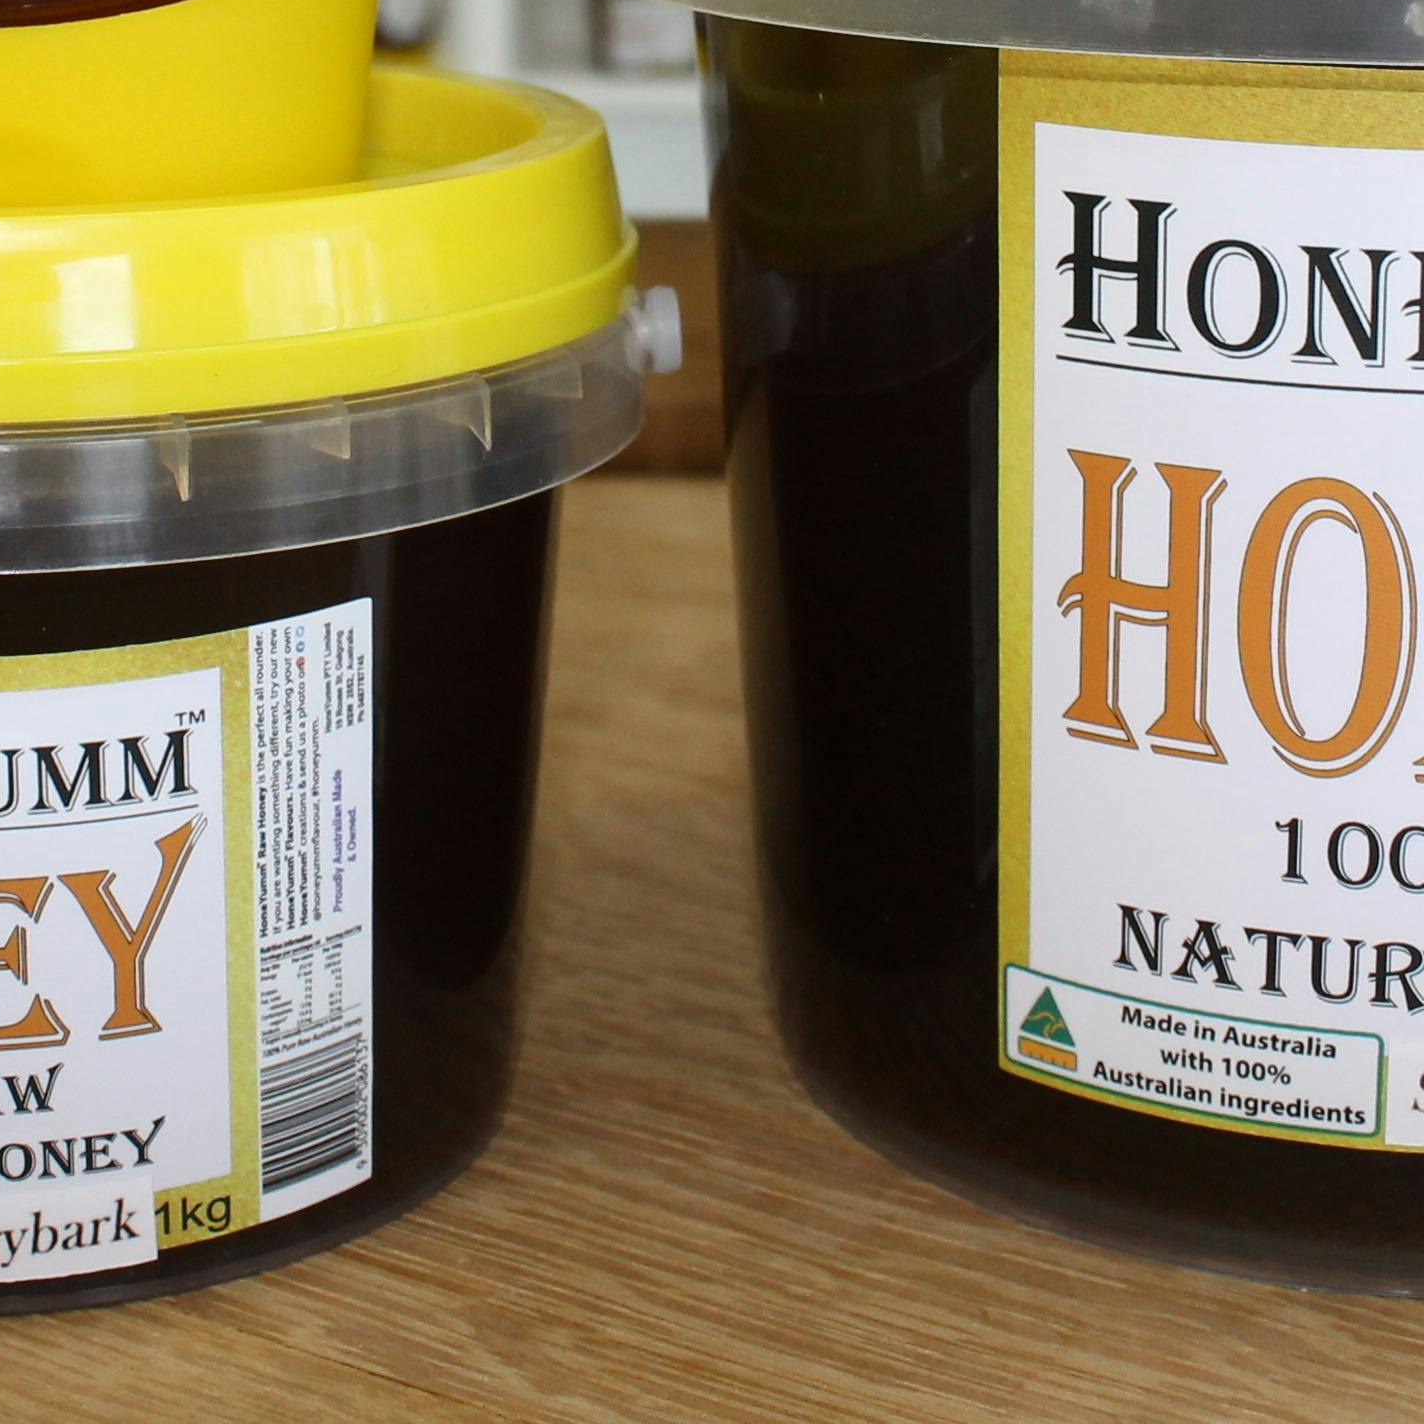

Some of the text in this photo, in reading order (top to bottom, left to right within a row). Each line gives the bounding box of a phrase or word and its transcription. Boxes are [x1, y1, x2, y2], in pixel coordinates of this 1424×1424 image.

[269, 628, 277, 654] new
[283, 626, 291, 654] own
[270, 657, 278, 679] our
[284, 657, 293, 685] your
[254, 687, 264, 701] all
[269, 681, 280, 699] try
[297, 681, 307, 719] photo
[283, 687, 294, 733] making
[255, 703, 266, 748] perfect
[299, 731, 306, 746] us
[283, 735, 293, 757] fun
[256, 751, 265, 772] the
[284, 759, 293, 790] Have
[297, 747, 306, 777] send
[256, 773, 265, 784] is
[270, 758, 281, 824] something
[297, 779, 306, 789] &
[257, 786, 267, 829] Honey
[299, 791, 307, 846] creations
[257, 830, 267, 859] Raw
[271, 826, 283, 878] wanting
[331, 768, 344, 912] Proudly Australian Made
[346, 852, 357, 862] &
[273, 879, 282, 898] are
[274, 900, 284, 924] you
[271, 925, 282, 935] If
[1120, 1005, 1337, 1059] Made in Australia
[1160, 1047, 1291, 1086] with 100%
[1092, 1060, 1366, 1125] Australian ingredients
[153, 1192, 232, 1237] 1kg
